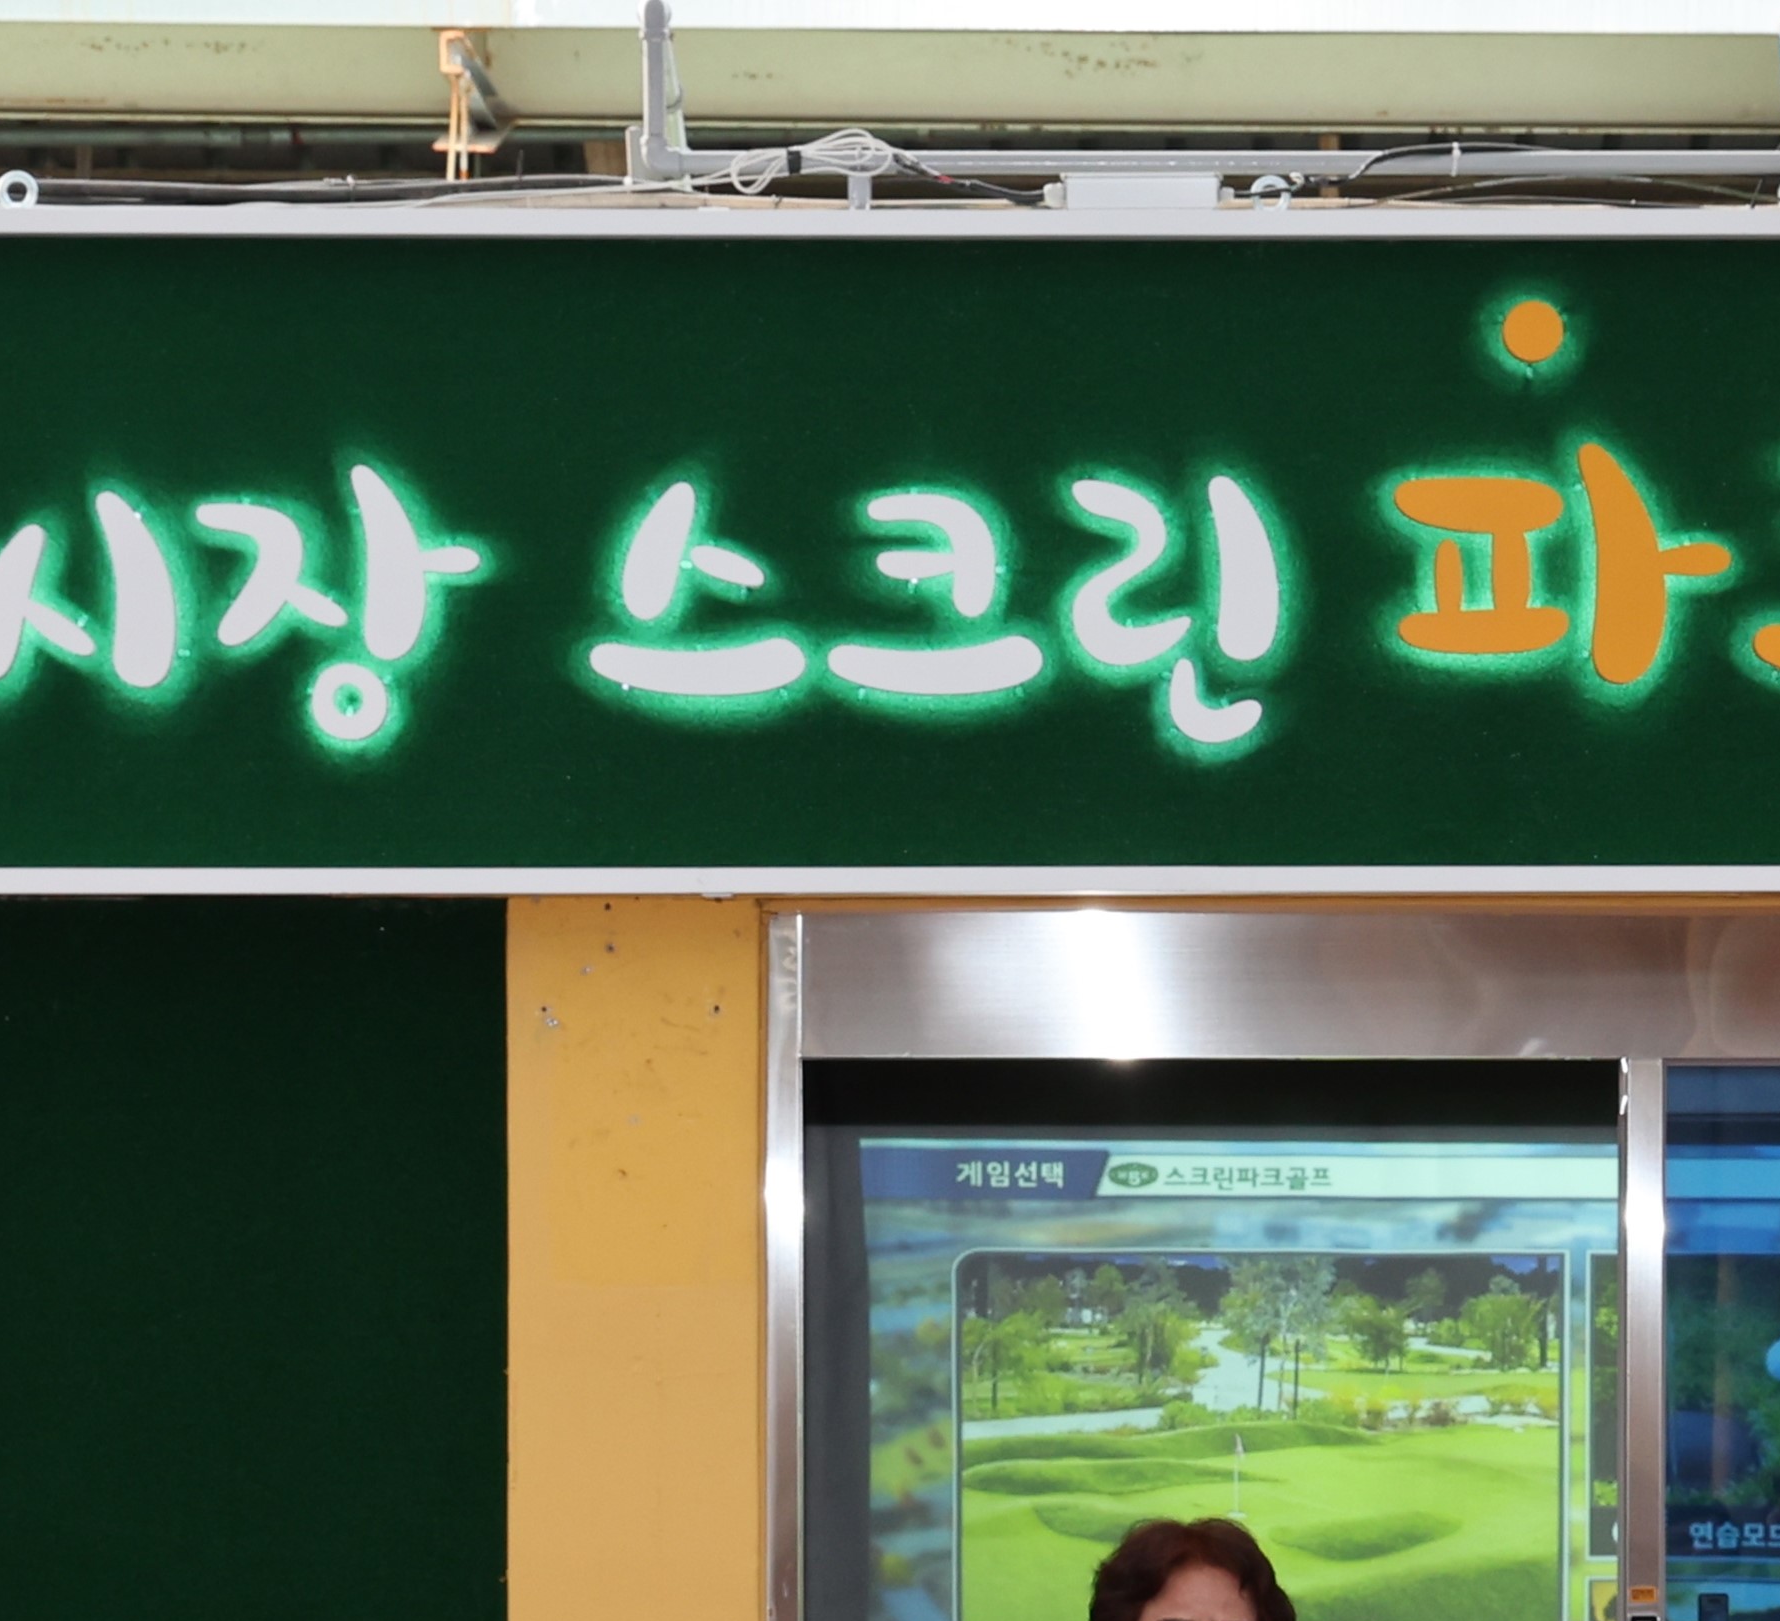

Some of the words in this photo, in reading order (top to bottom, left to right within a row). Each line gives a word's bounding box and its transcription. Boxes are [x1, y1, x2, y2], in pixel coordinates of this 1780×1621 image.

[589, 475, 1282, 746] 스크린
[955, 1160, 1065, 1189] 게임선택
[1164, 1164, 1332, 1190] 스크린파크골프
